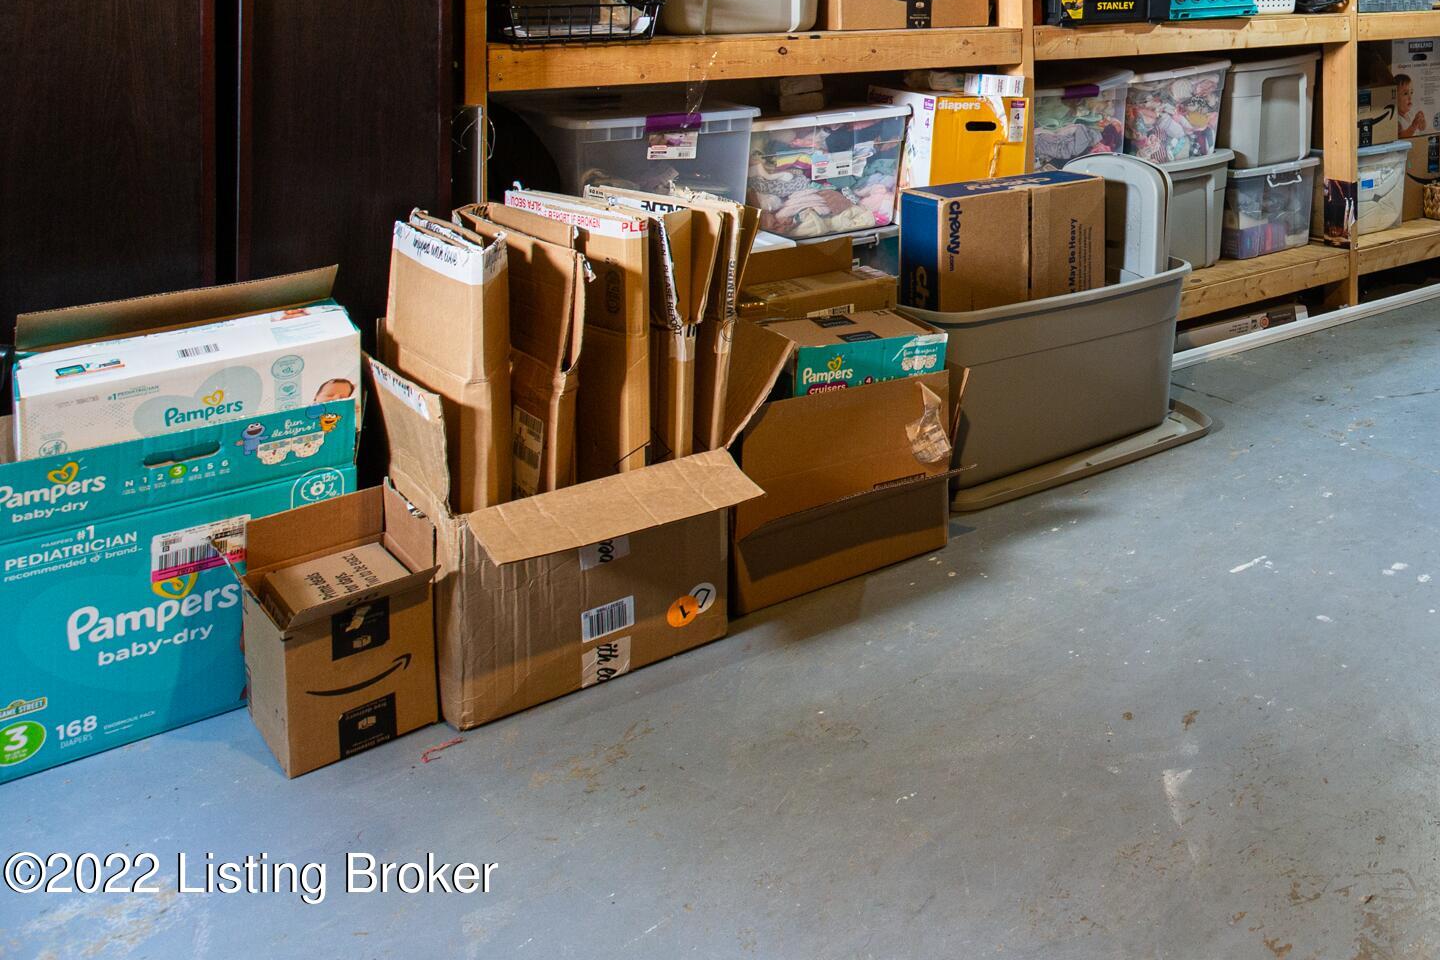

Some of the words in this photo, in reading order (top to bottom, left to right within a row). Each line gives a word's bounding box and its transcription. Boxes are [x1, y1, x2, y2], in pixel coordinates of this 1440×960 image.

[1097, 1, 1134, 11] STANLEY
[937, 99, 981, 112] diapers
[1069, 217, 1078, 248] Heavy
[1069, 249, 1076, 264] Be
[726, 257, 737, 318] WARNING
[1068, 264, 1077, 292] May
[802, 367, 854, 386] Pampers
[808, 384, 847, 396] cruisers
[164, 400, 244, 427] Pampers
[125, 479, 134, 487] N
[12, 500, 89, 524] baby-dry
[76, 525, 96, 541] #1
[4, 531, 138, 572] PEDIATRICIAN
[3, 557, 87, 583] recommended
[67, 583, 240, 651] Pampers
[97, 624, 214, 666] baby-dry
[4, 725, 28, 751] 3
[55, 715, 98, 741] 168
[60, 732, 94, 750] DIAPERS
